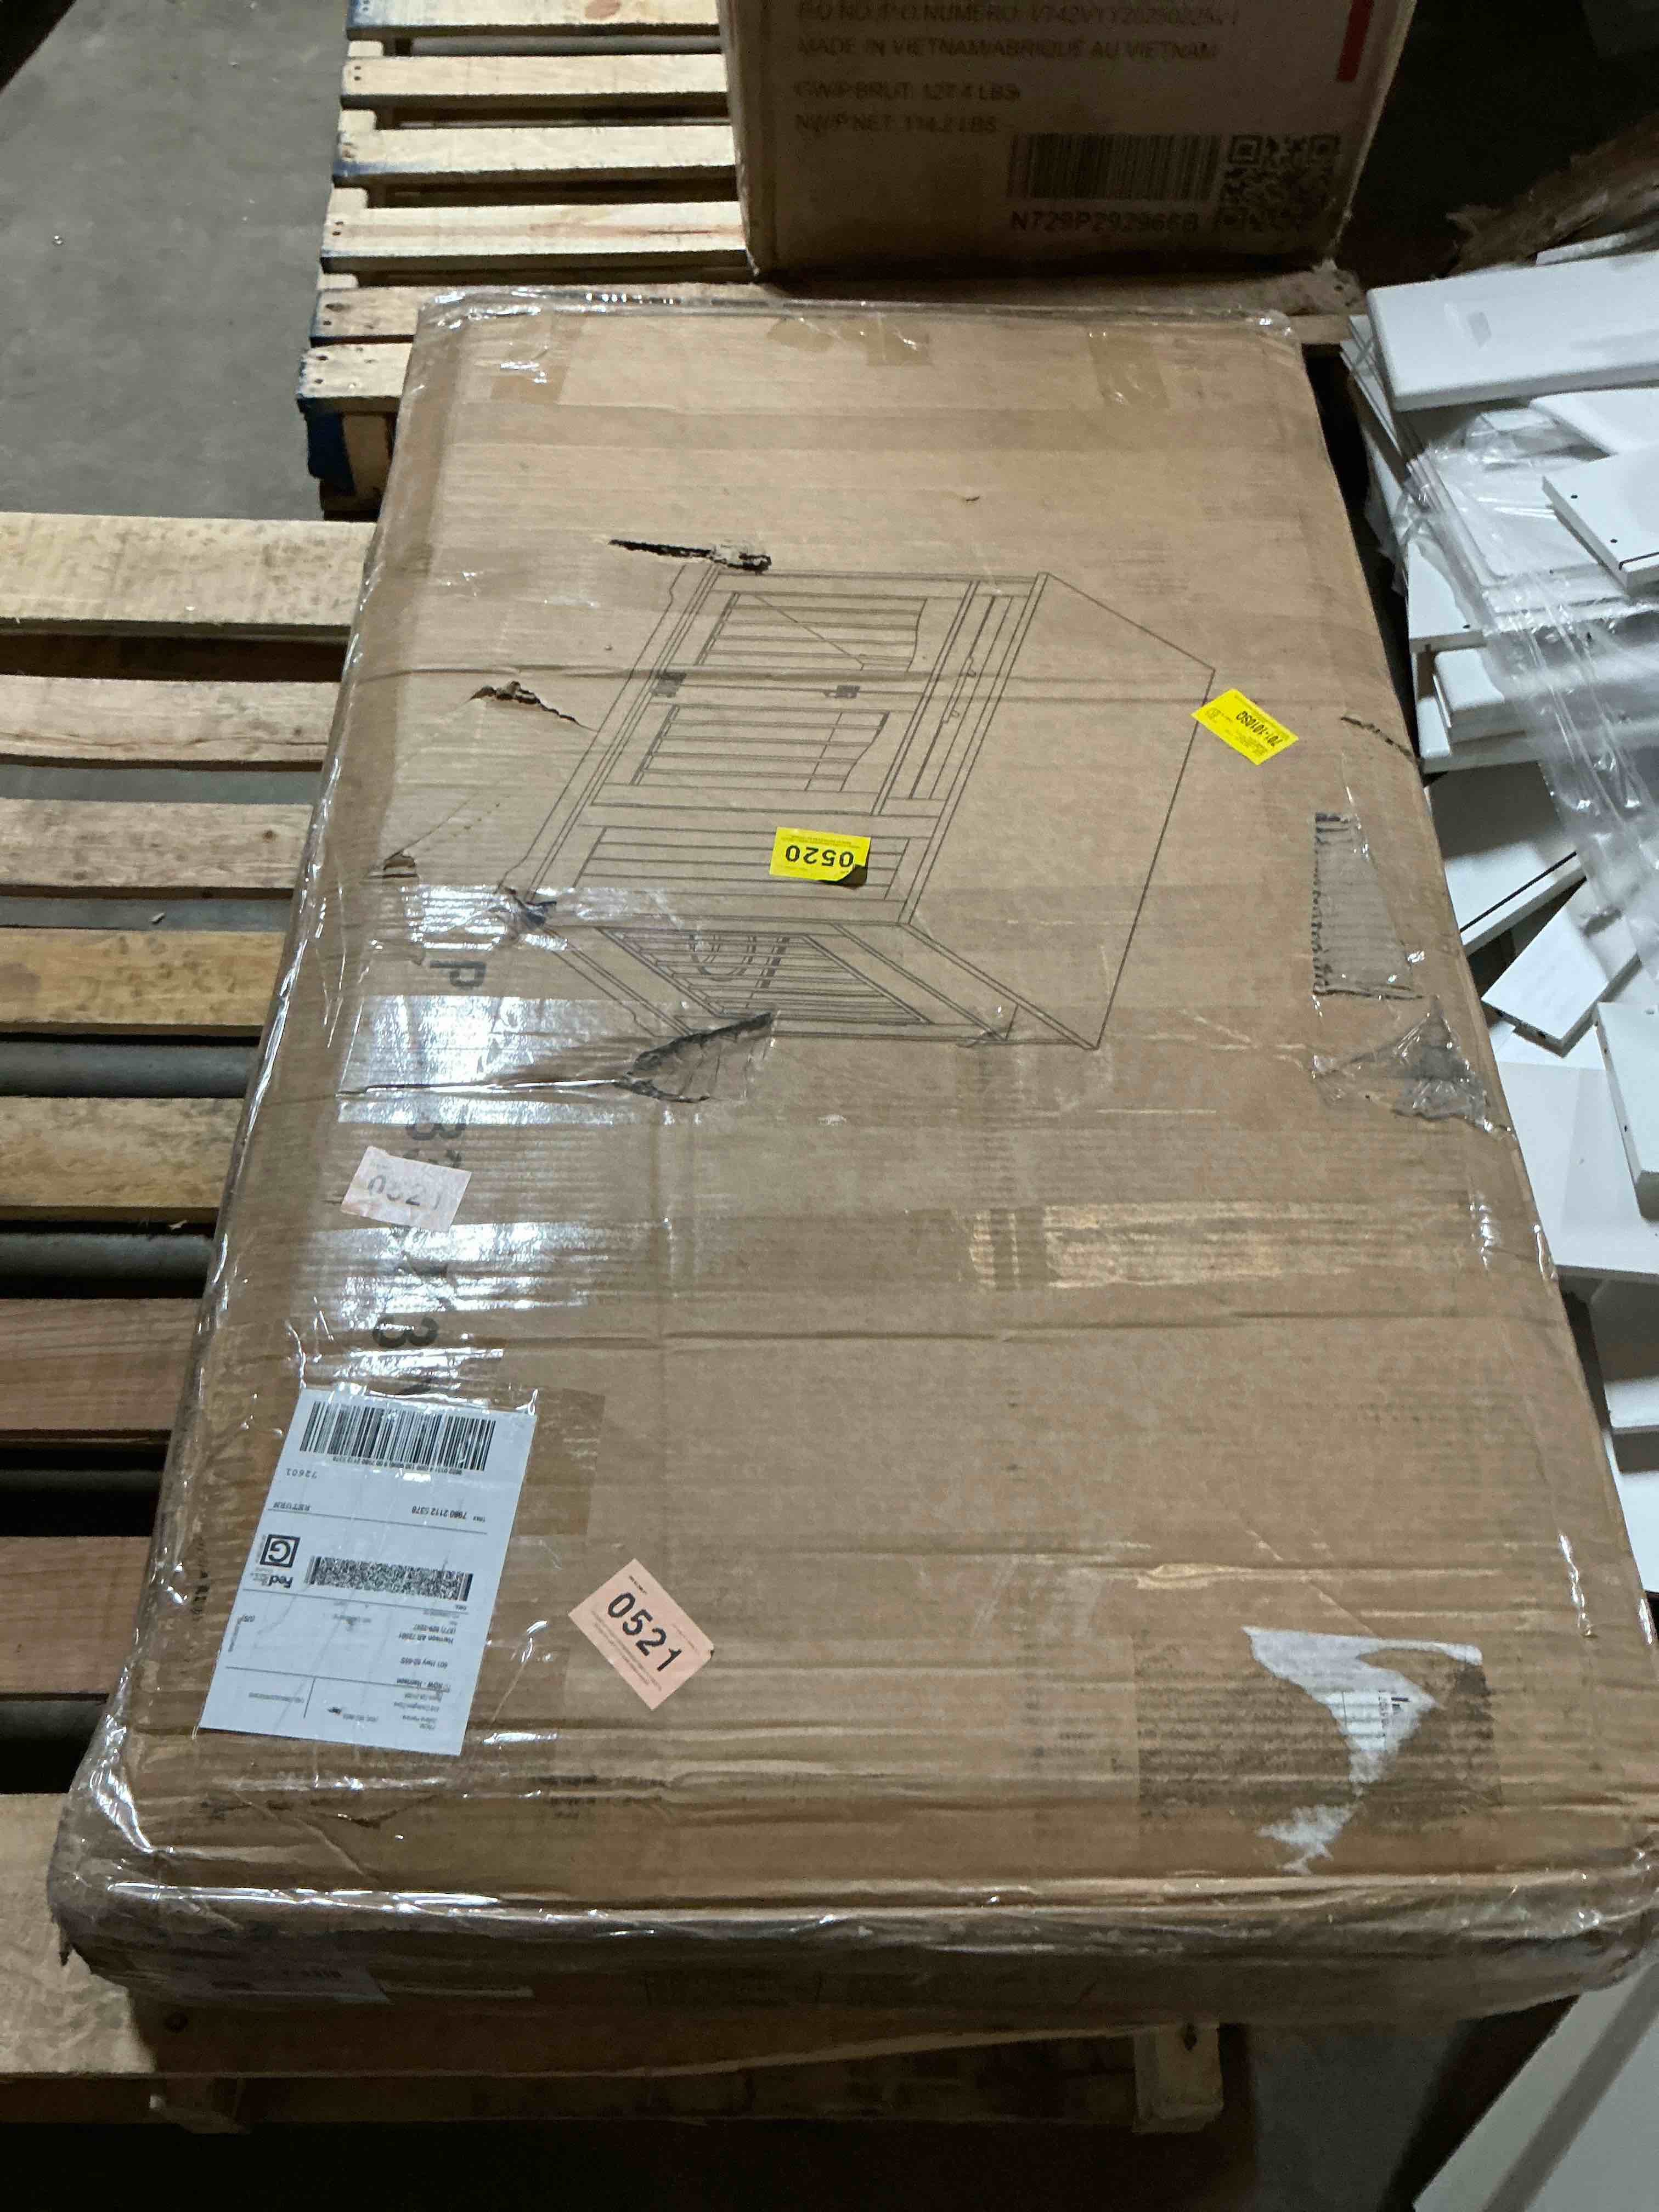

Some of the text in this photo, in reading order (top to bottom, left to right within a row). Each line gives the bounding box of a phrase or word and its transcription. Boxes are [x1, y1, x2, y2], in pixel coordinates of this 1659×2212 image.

[786, 845, 854, 867] 0520
[285, 1468, 318, 1479] 72601
[273, 1502, 311, 1511] RETURN
[431, 1508, 448, 1517] 2112
[268, 1541, 291, 1562] G
[608, 1592, 682, 1672] 0521
